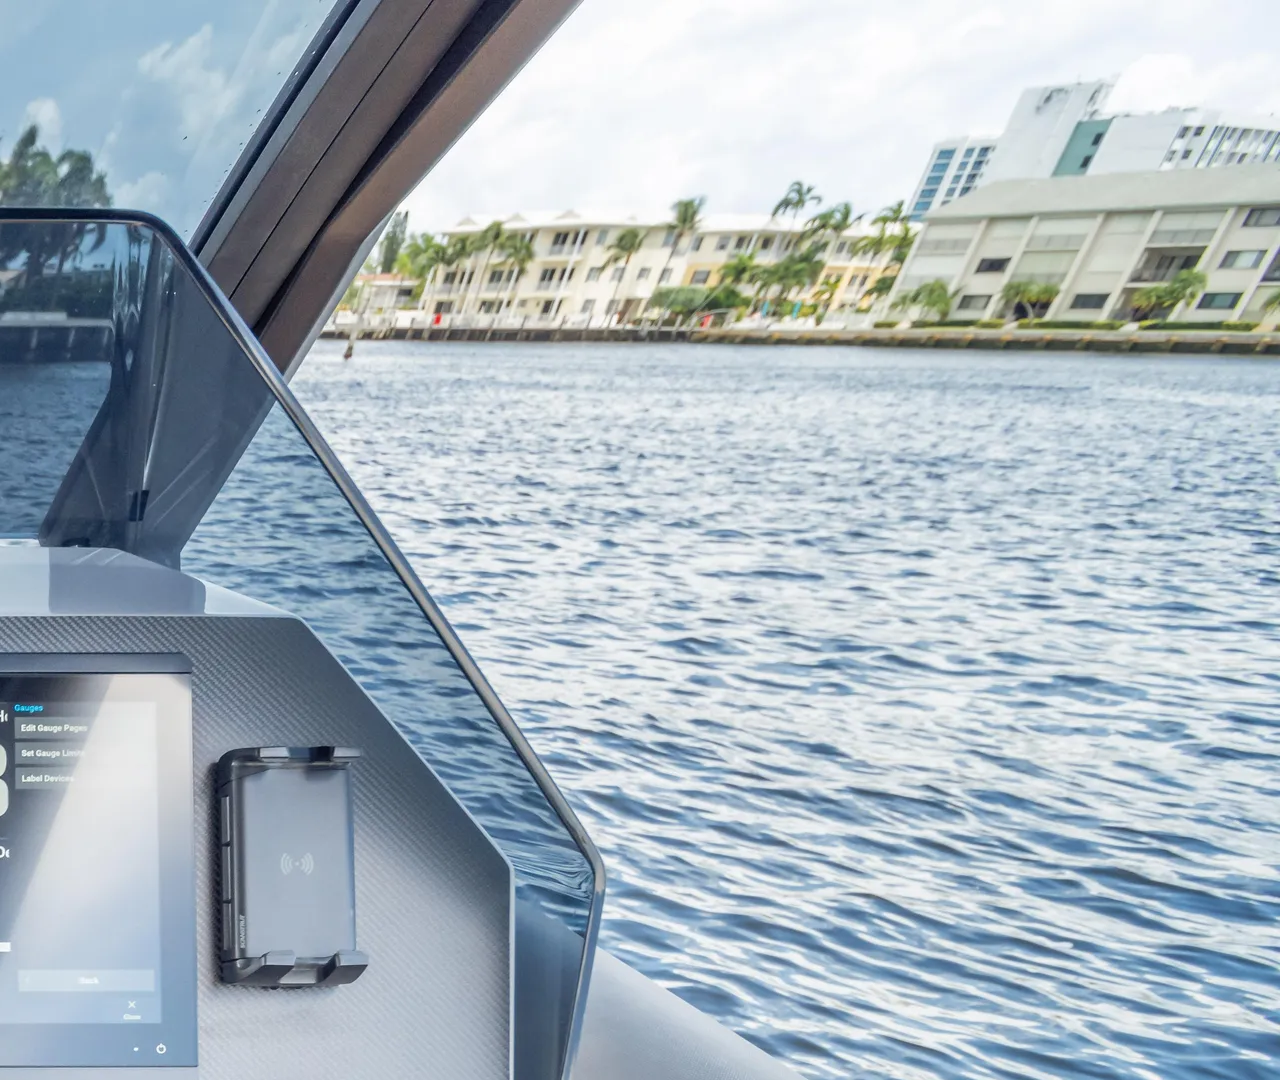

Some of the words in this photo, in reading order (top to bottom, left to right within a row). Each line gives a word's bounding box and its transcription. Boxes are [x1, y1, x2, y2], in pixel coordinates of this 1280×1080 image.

[14, 704, 44, 713] Gauges
[20, 724, 36, 732] Edit
[37, 724, 62, 734] Gauge
[21, 749, 33, 757] Set
[35, 749, 61, 759] Gauge
[21, 774, 43, 783] Label
